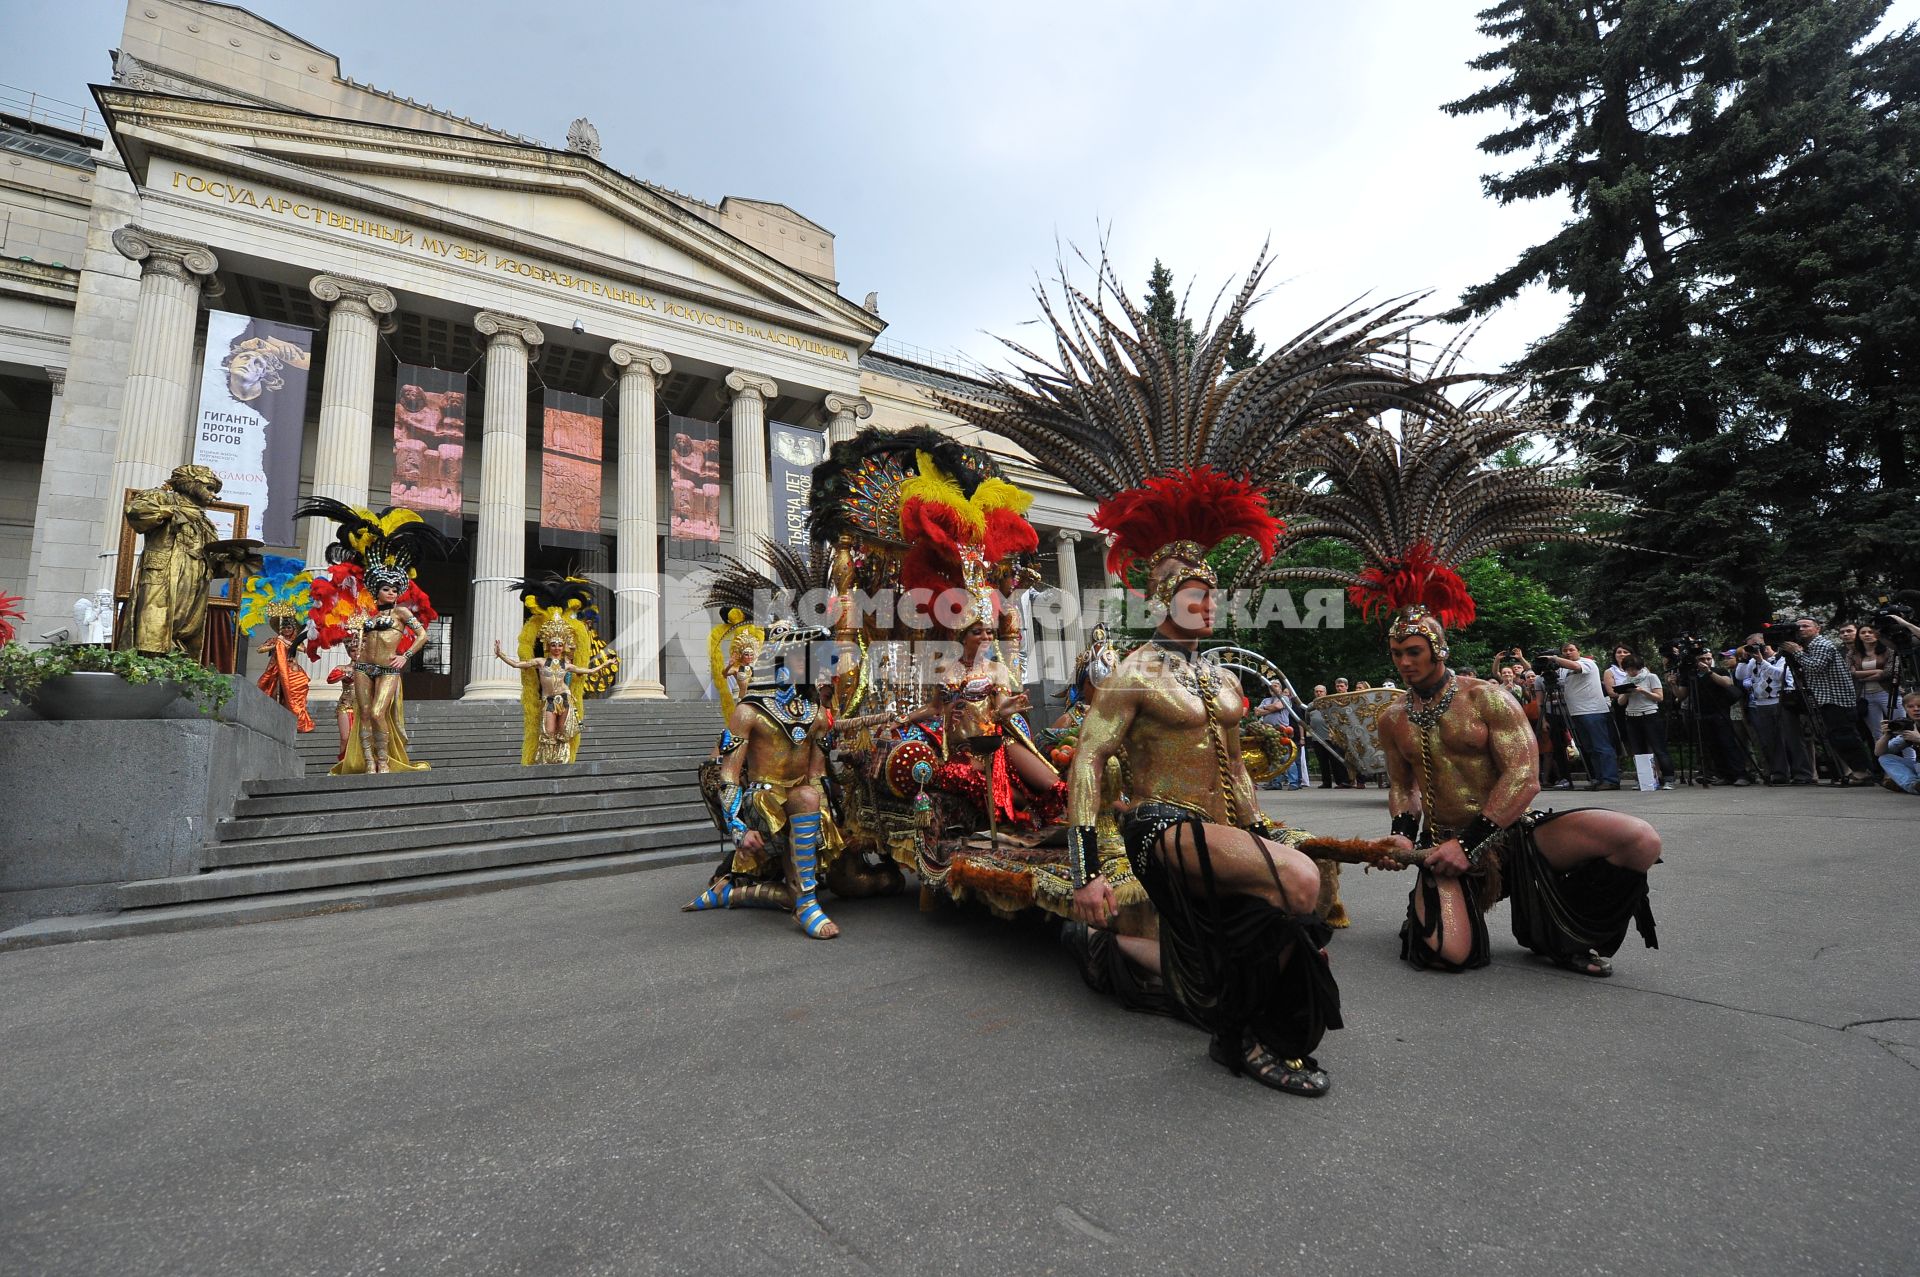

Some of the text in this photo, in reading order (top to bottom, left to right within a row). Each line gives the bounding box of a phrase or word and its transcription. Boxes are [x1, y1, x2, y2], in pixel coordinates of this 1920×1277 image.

[172, 171, 413, 246] ГОСУДАРСТВЕННЫЙ
[420, 233, 487, 266] МУЗЕЙ
[495, 256, 656, 310] ИЗОБРАЗИТЕЛЬНЫХ
[663, 301, 744, 334] ИСКУССТВ
[204, 410, 259, 426] ГИГАНТЫ
[203, 422, 244, 434] против
[202, 432, 241, 445] БОГОВ
[785, 470, 803, 546] ТЫСЯЧА ЛЕТ
